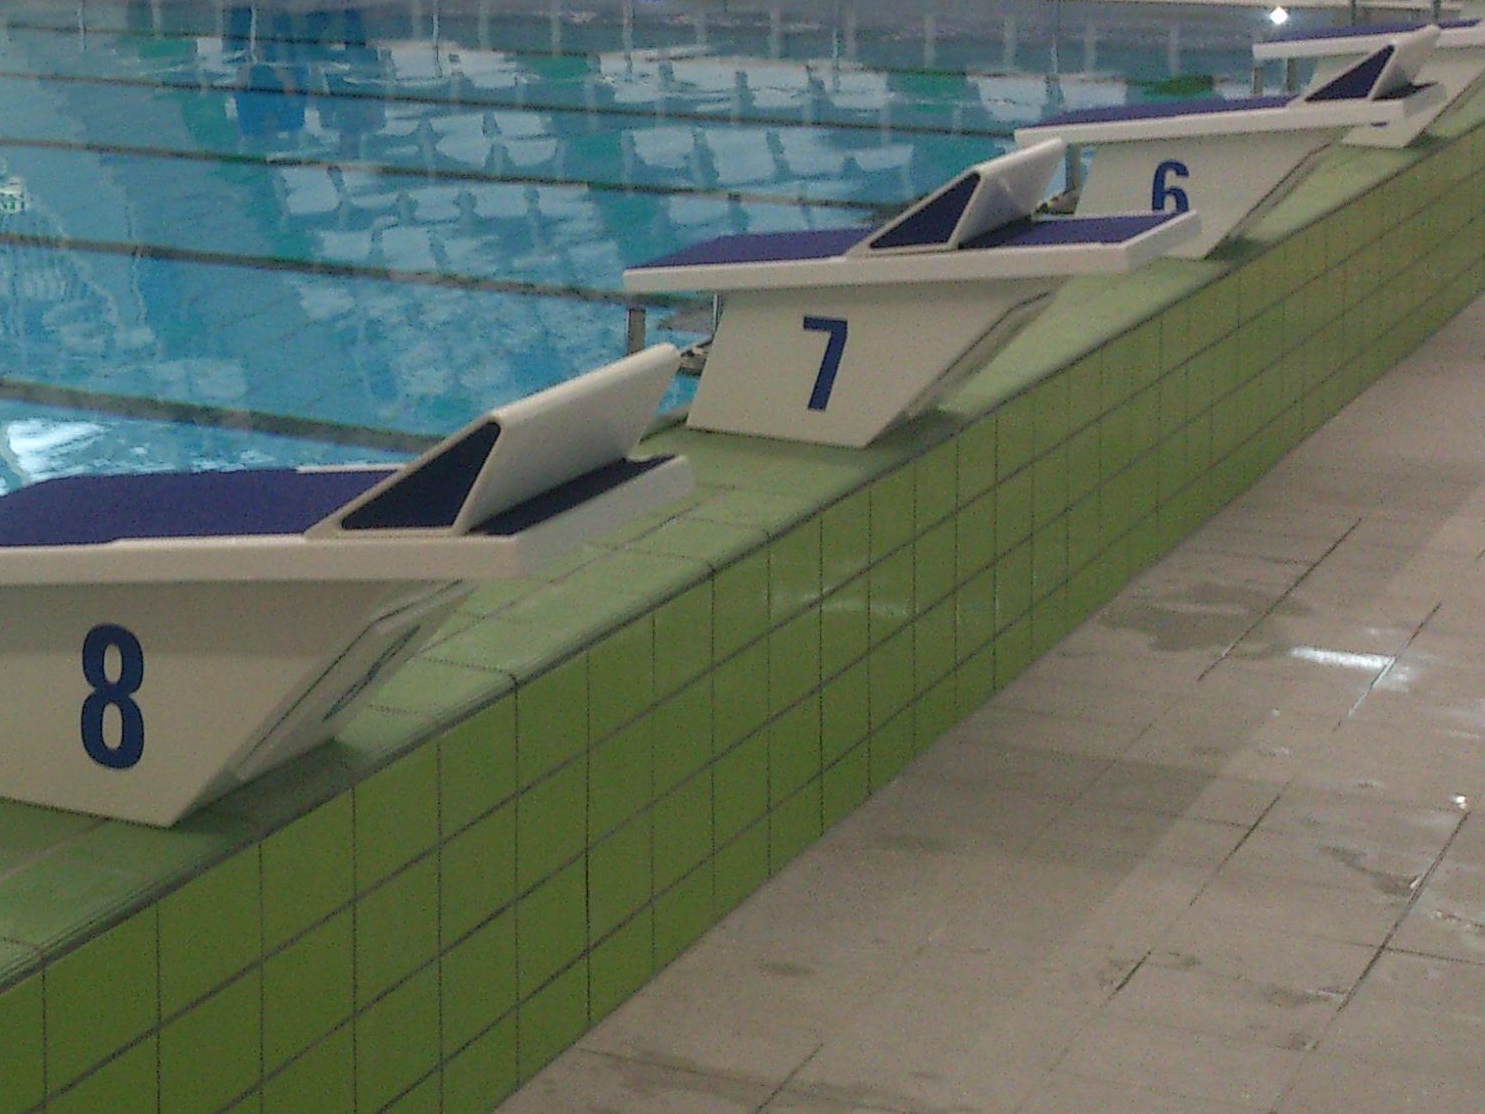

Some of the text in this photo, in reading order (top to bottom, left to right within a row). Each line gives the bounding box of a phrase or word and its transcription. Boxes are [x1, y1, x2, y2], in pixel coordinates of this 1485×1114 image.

[1151, 160, 1190, 212] 6
[803, 315, 848, 411] 7
[80, 623, 145, 769] 8
